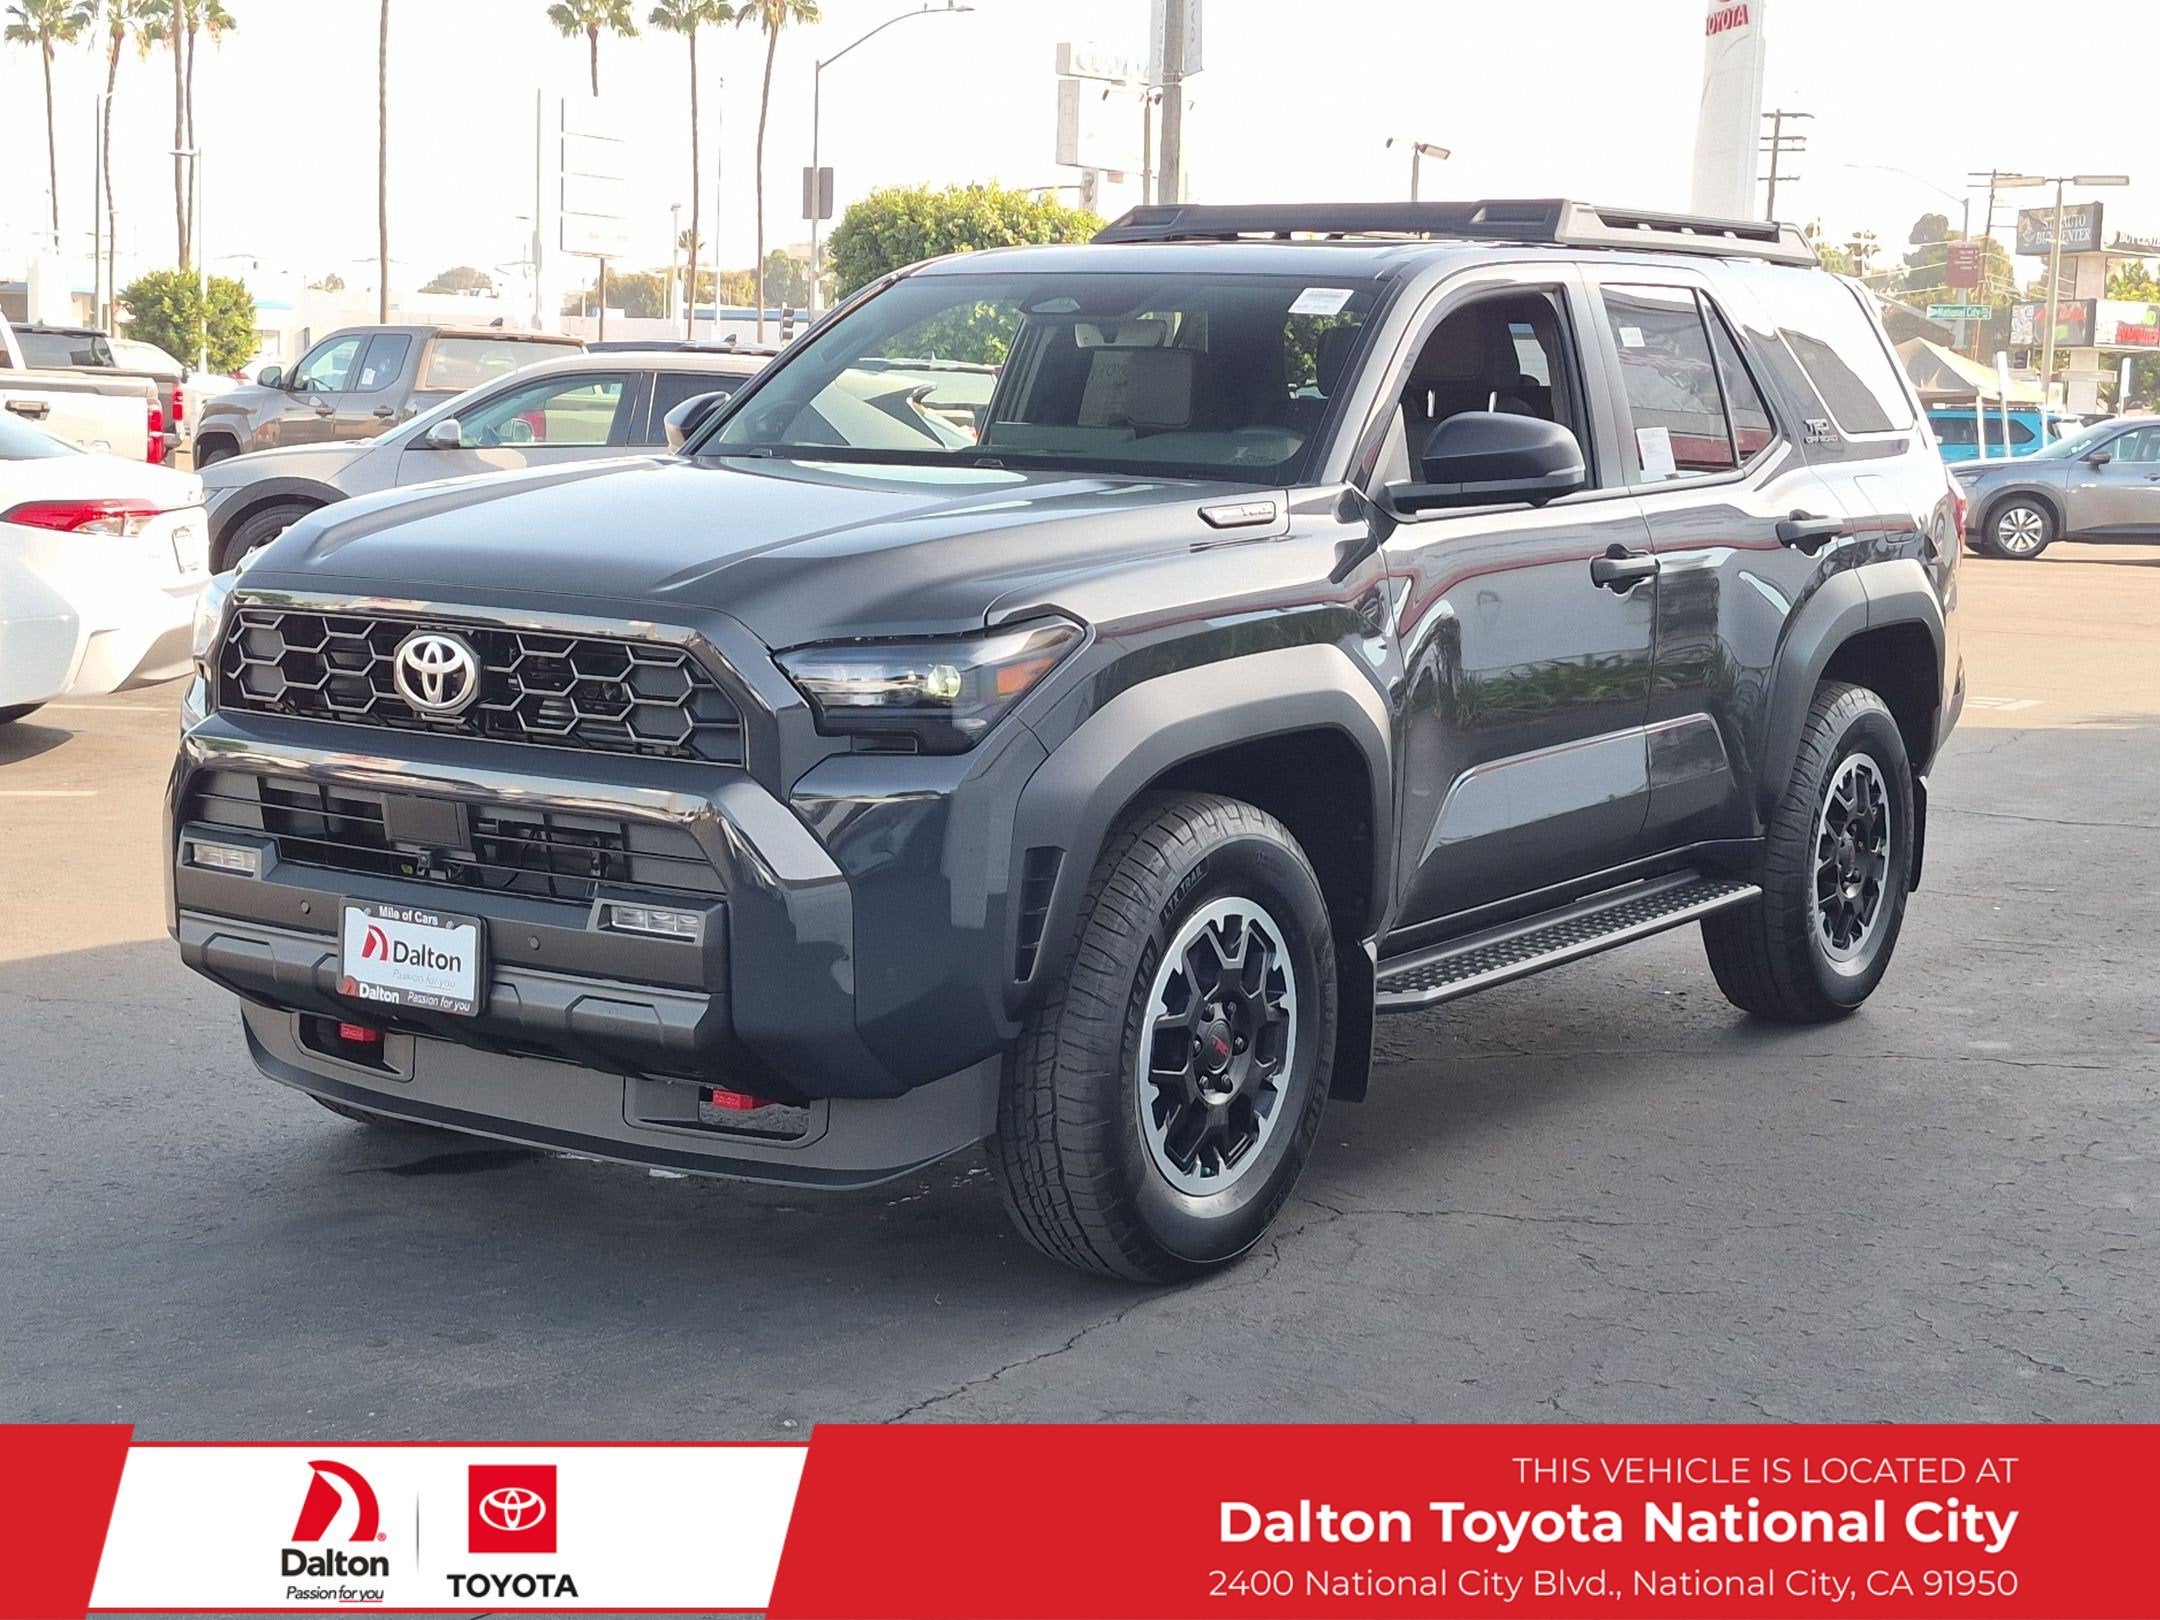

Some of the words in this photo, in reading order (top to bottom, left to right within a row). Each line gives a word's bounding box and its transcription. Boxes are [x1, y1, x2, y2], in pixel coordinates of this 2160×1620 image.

[1705, 4, 1749, 36] OYOTA
[379, 905, 400, 920] Mile
[402, 909, 413, 922] of
[414, 912, 438, 926] Cars
[393, 940, 462, 972] Dalton
[359, 983, 400, 1004] Dalton
[407, 991, 439, 1006] Passion
[440, 995, 453, 1008] for
[454, 1000, 471, 1012] you
